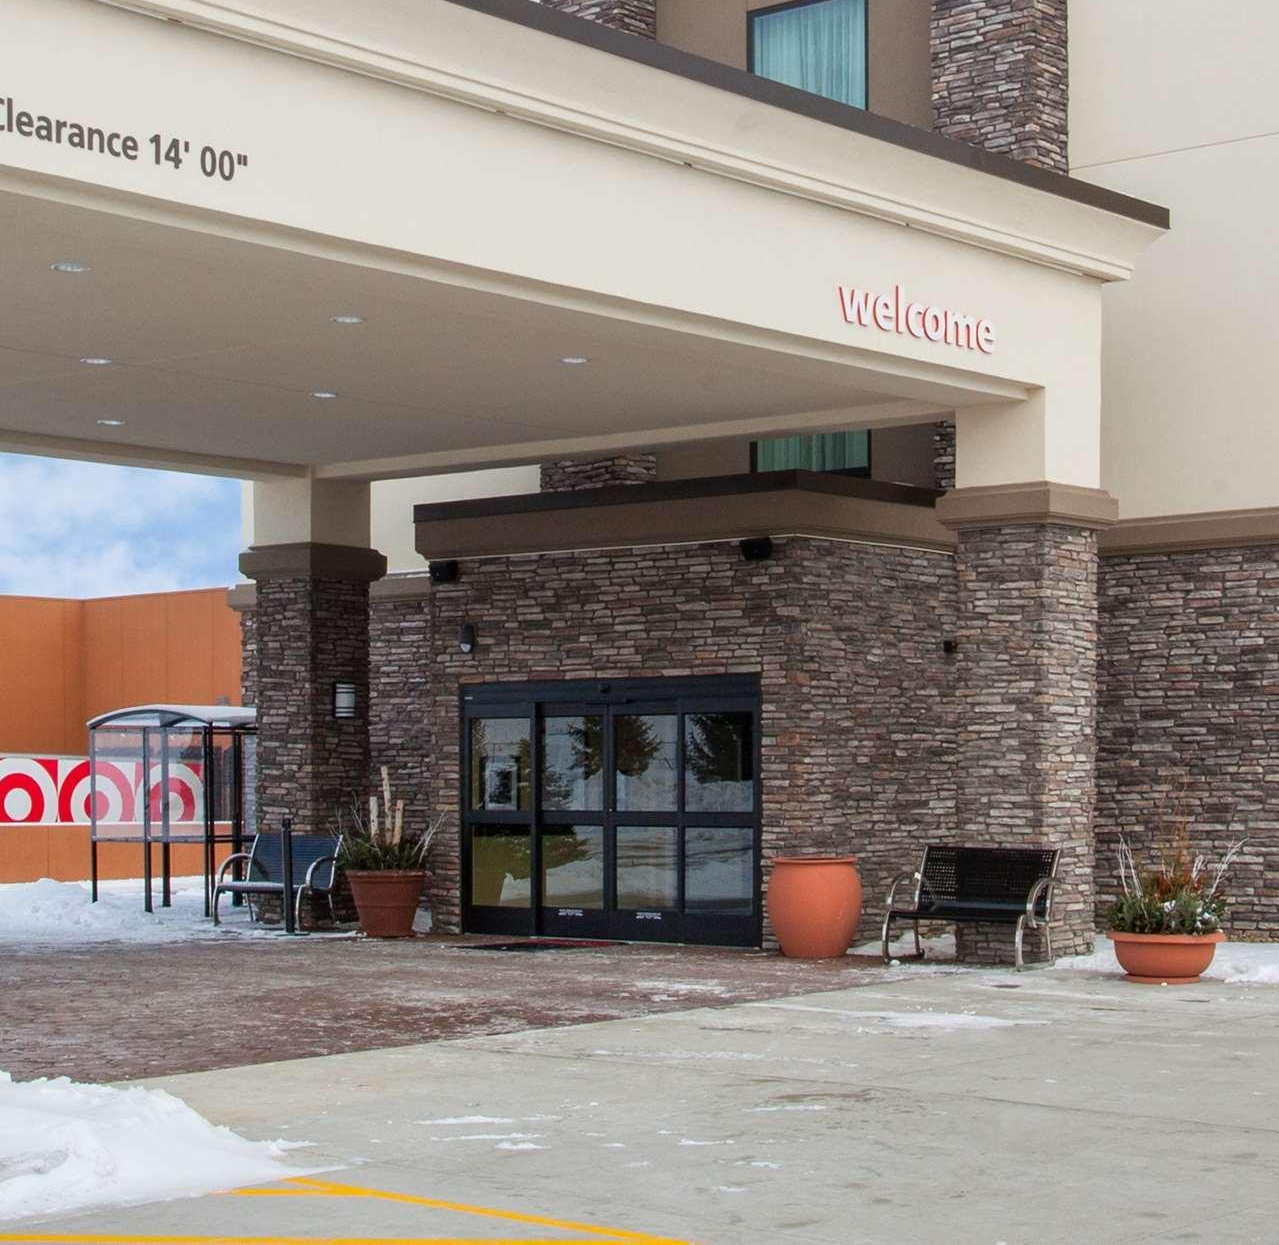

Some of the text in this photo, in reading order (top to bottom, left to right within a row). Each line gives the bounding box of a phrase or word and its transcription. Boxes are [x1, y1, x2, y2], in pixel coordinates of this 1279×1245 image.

[149, 133, 190, 169] 14'
[200, 145, 248, 181] 00"
[837, 285, 996, 354] welcome
